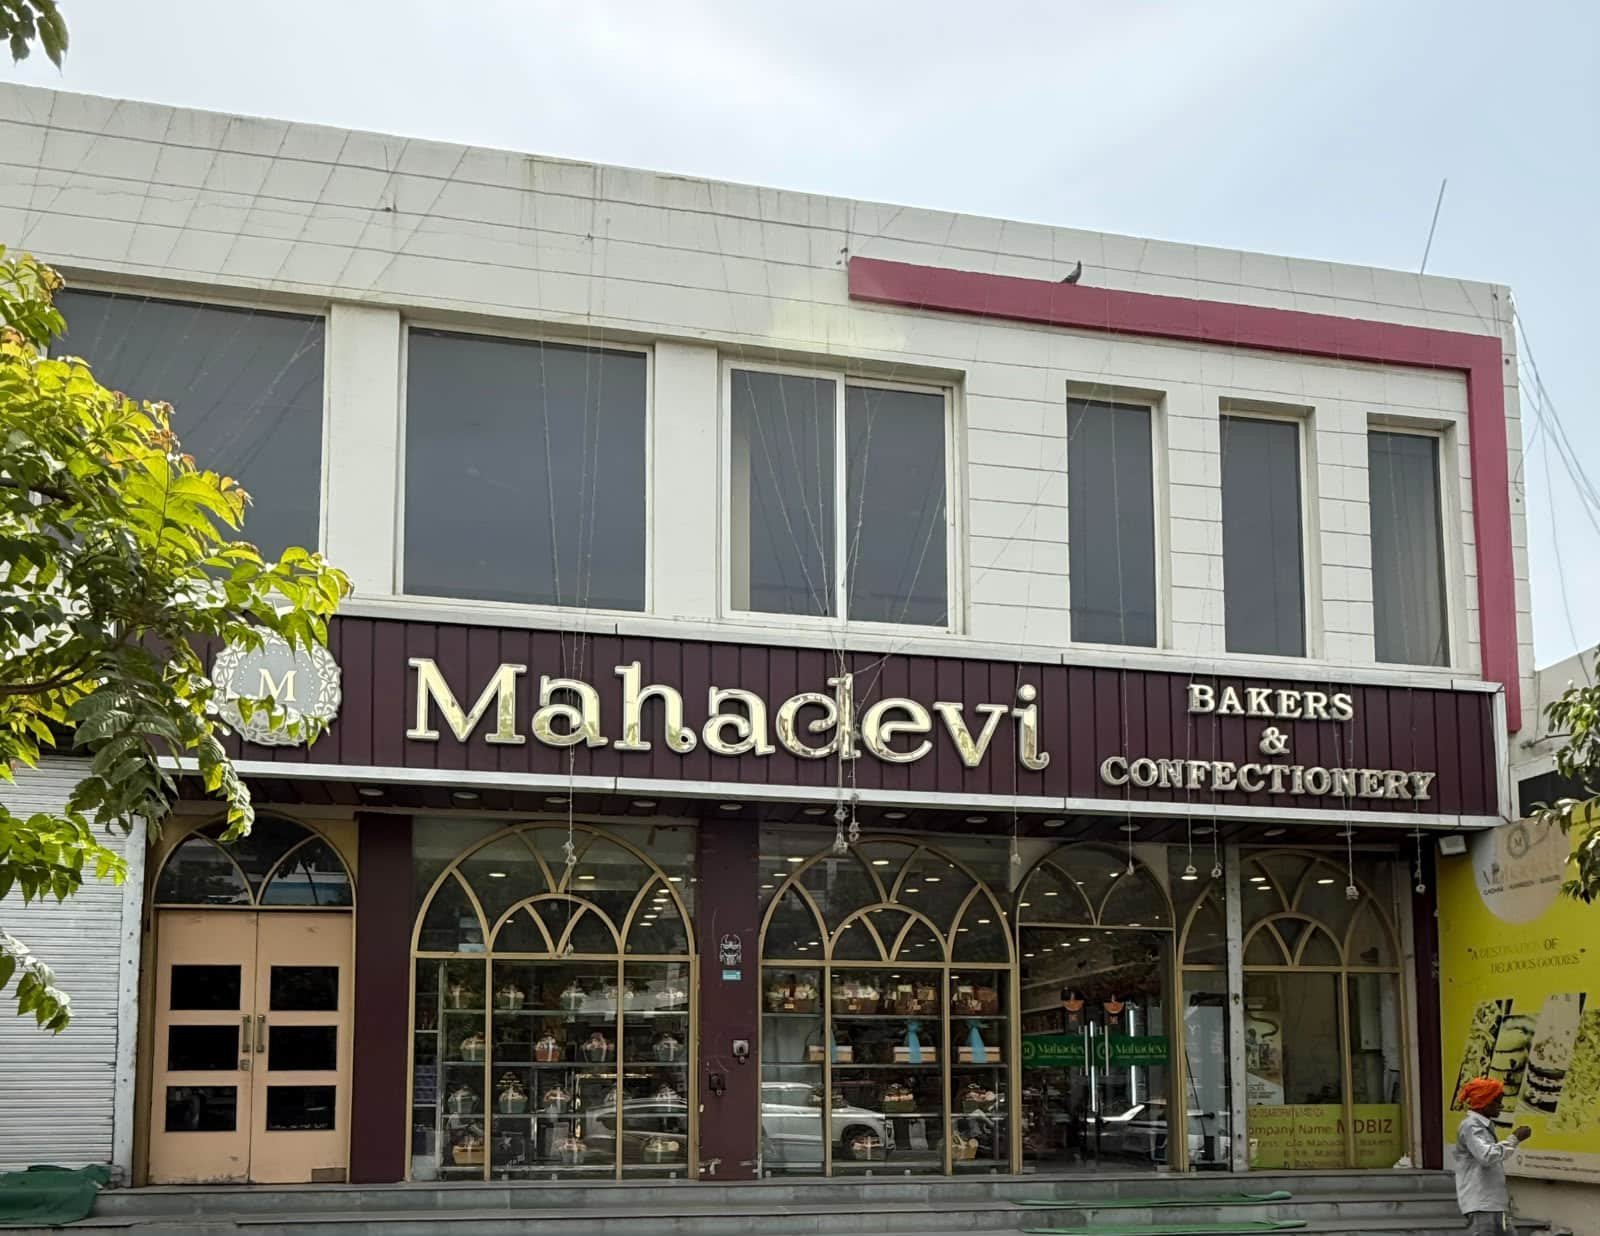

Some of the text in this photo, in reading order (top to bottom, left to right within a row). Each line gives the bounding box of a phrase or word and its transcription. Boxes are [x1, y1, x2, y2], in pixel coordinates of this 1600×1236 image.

[257, 668, 299, 701] M
[405, 657, 1051, 770] Mahadevi
[1187, 684, 1354, 721] BAKERS
[1260, 726, 1290, 755] &
[1100, 756, 1436, 800] CONFECTIONERY
[1544, 937, 1559, 951] OF
